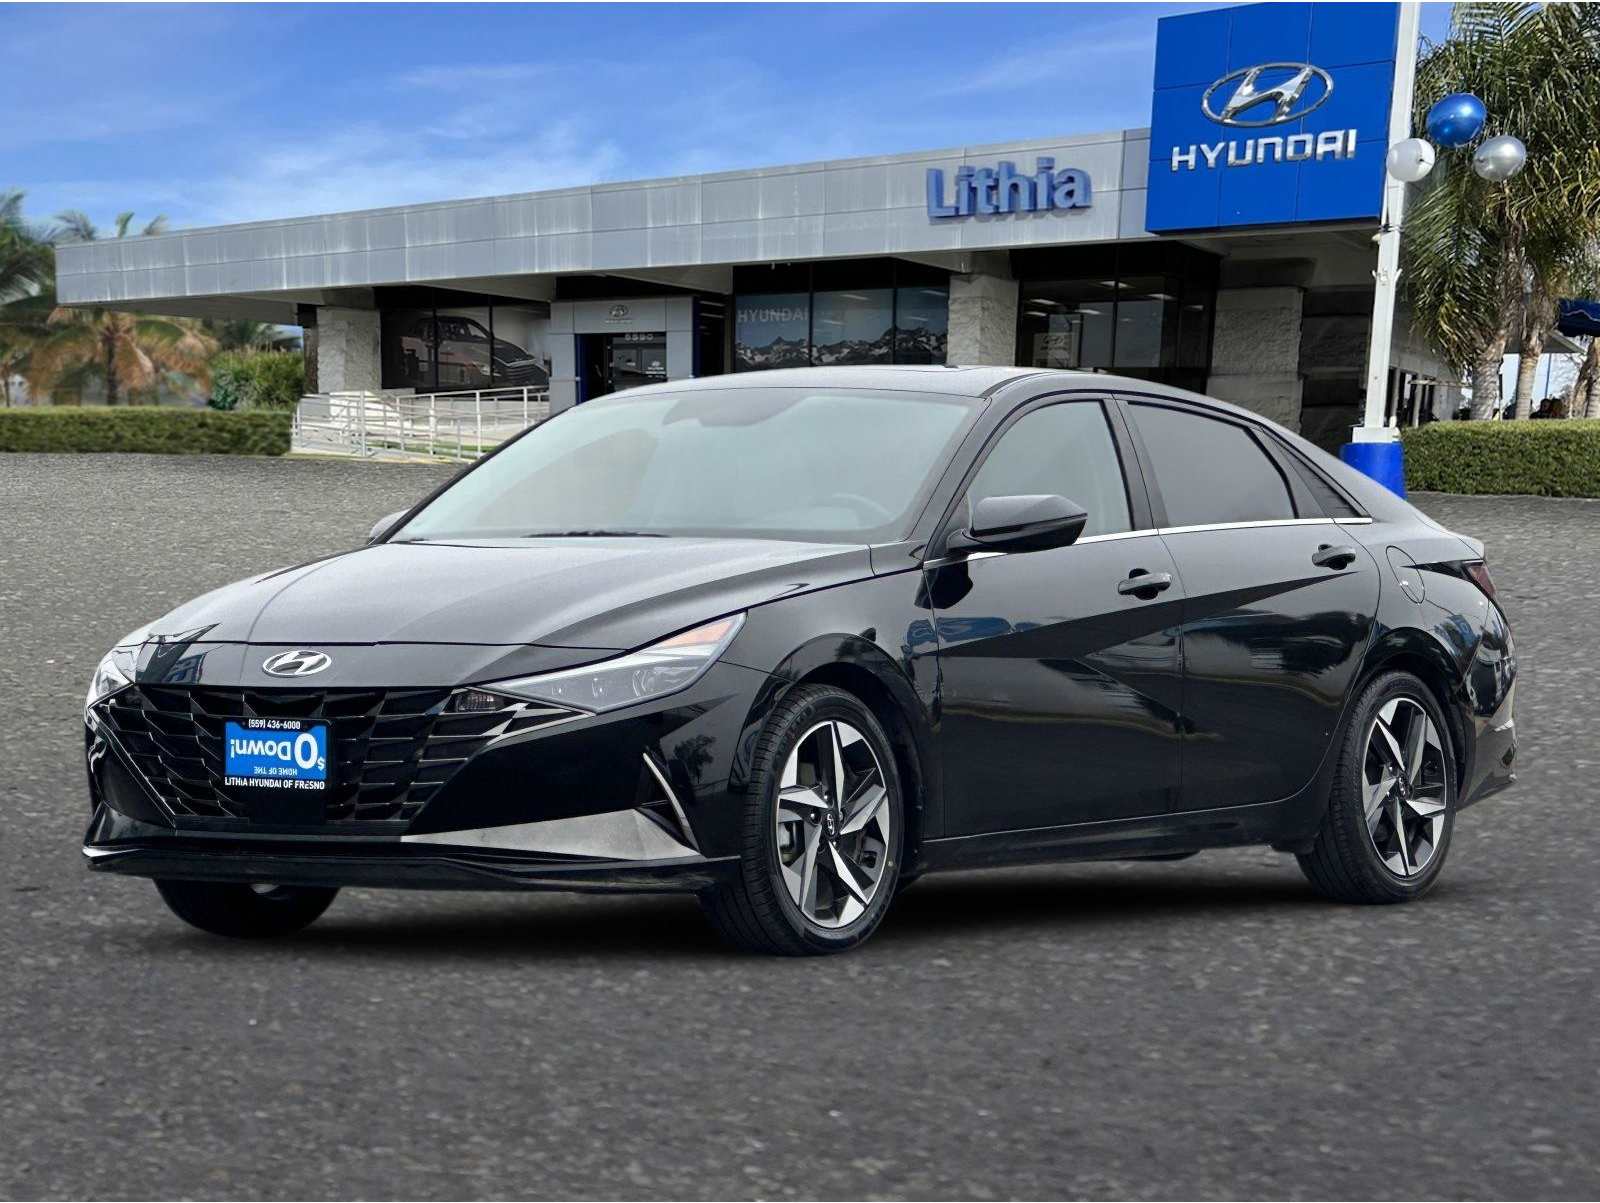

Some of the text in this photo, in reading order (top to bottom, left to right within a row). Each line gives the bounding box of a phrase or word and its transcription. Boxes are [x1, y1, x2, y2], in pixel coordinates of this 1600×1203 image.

[1171, 128, 1357, 172] HYUNDAI
[926, 156, 1092, 218] Lithia
[737, 307, 809, 323] HYUNDAI
[248, 718, 301, 730] (559) 436-6000
[230, 739, 292, 761] Down!
[224, 776, 325, 790] LITHIA HYUNDAI OF FRESNO
